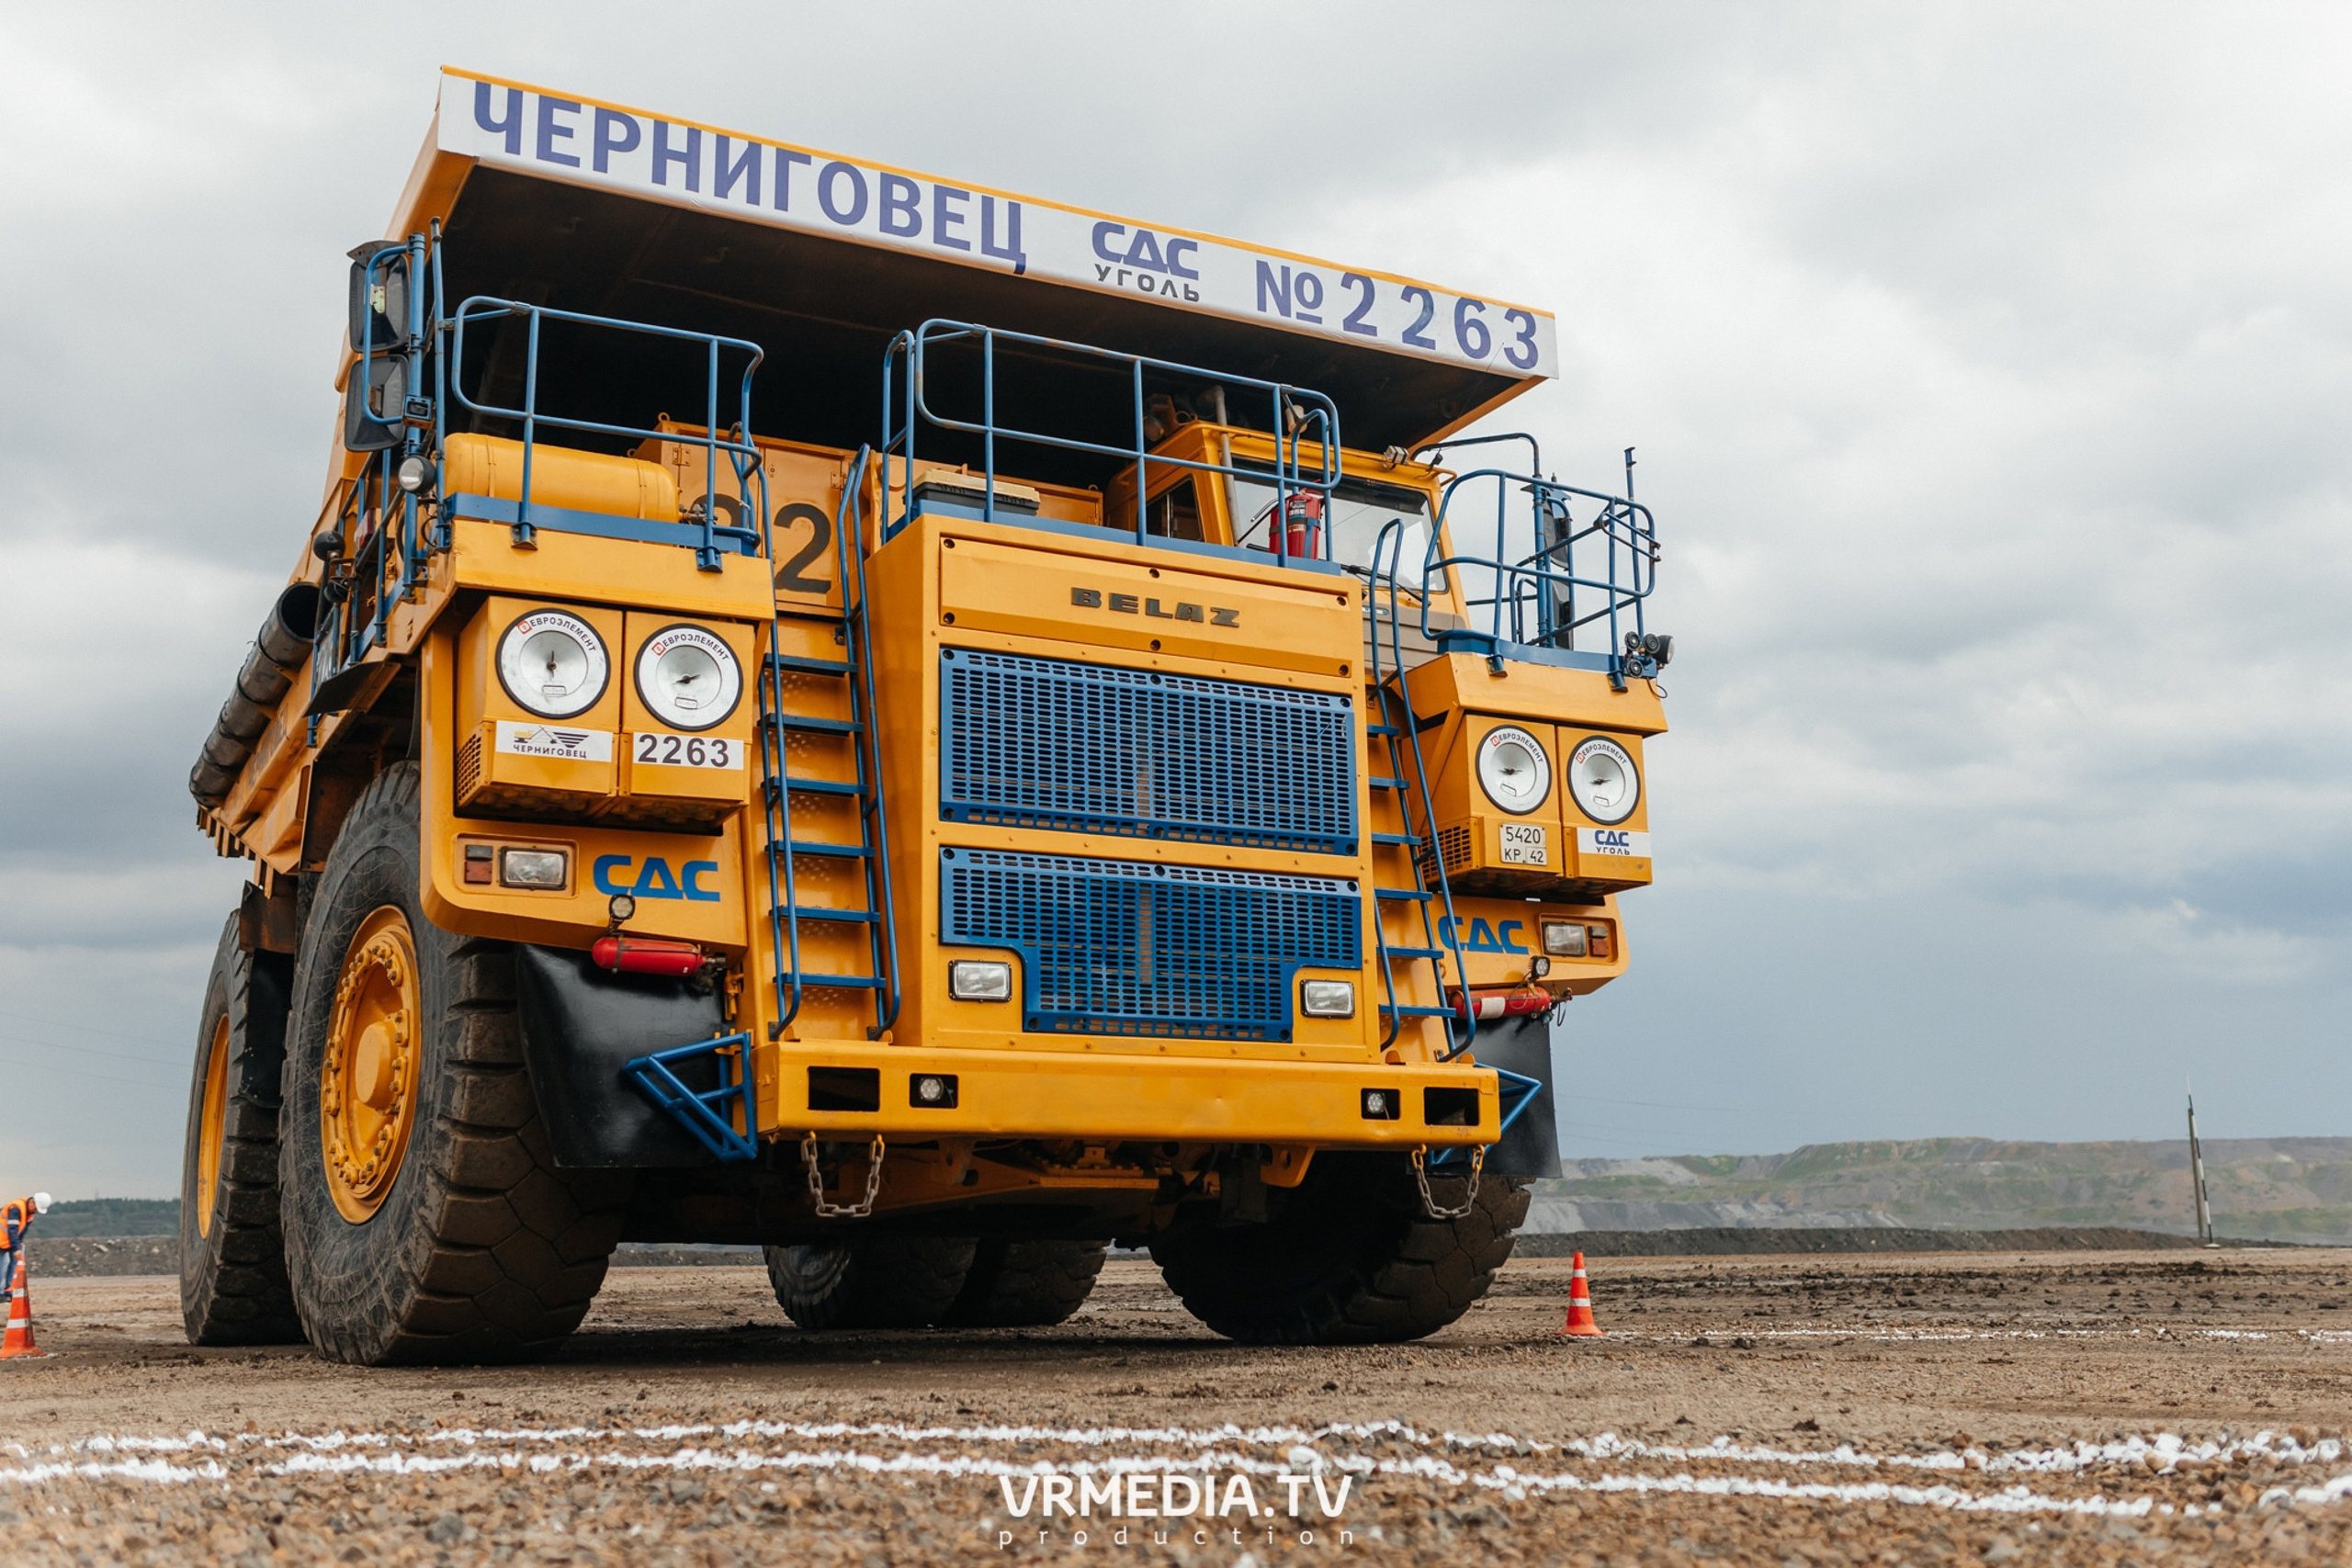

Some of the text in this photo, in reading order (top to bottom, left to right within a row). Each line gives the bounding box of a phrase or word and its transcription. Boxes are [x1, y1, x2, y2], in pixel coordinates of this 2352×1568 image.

[474, 81, 1026, 275] ЧЕРНИГОВЕЦ
[1094, 264, 1200, 302] УГОЛЬ
[1071, 587, 1239, 627] BELAZ
[530, 617, 595, 651] ЕВРОЭЛЕМЕНТ
[662, 634, 729, 660] ЕВРОЭЛЕМЕНТ
[514, 744, 587, 759] ЧЕРНИГОВЕЦ
[638, 734, 729, 768] 2263
[1498, 733, 1544, 762] ЕВРОЭЛЕМЕНТ
[1582, 744, 1627, 764] ЕВРОЭЛЕМЕНТ
[1506, 827, 1541, 843] 5420
[1530, 850, 1544, 863] 42
[1596, 846, 1630, 855] УГОЛЬ
